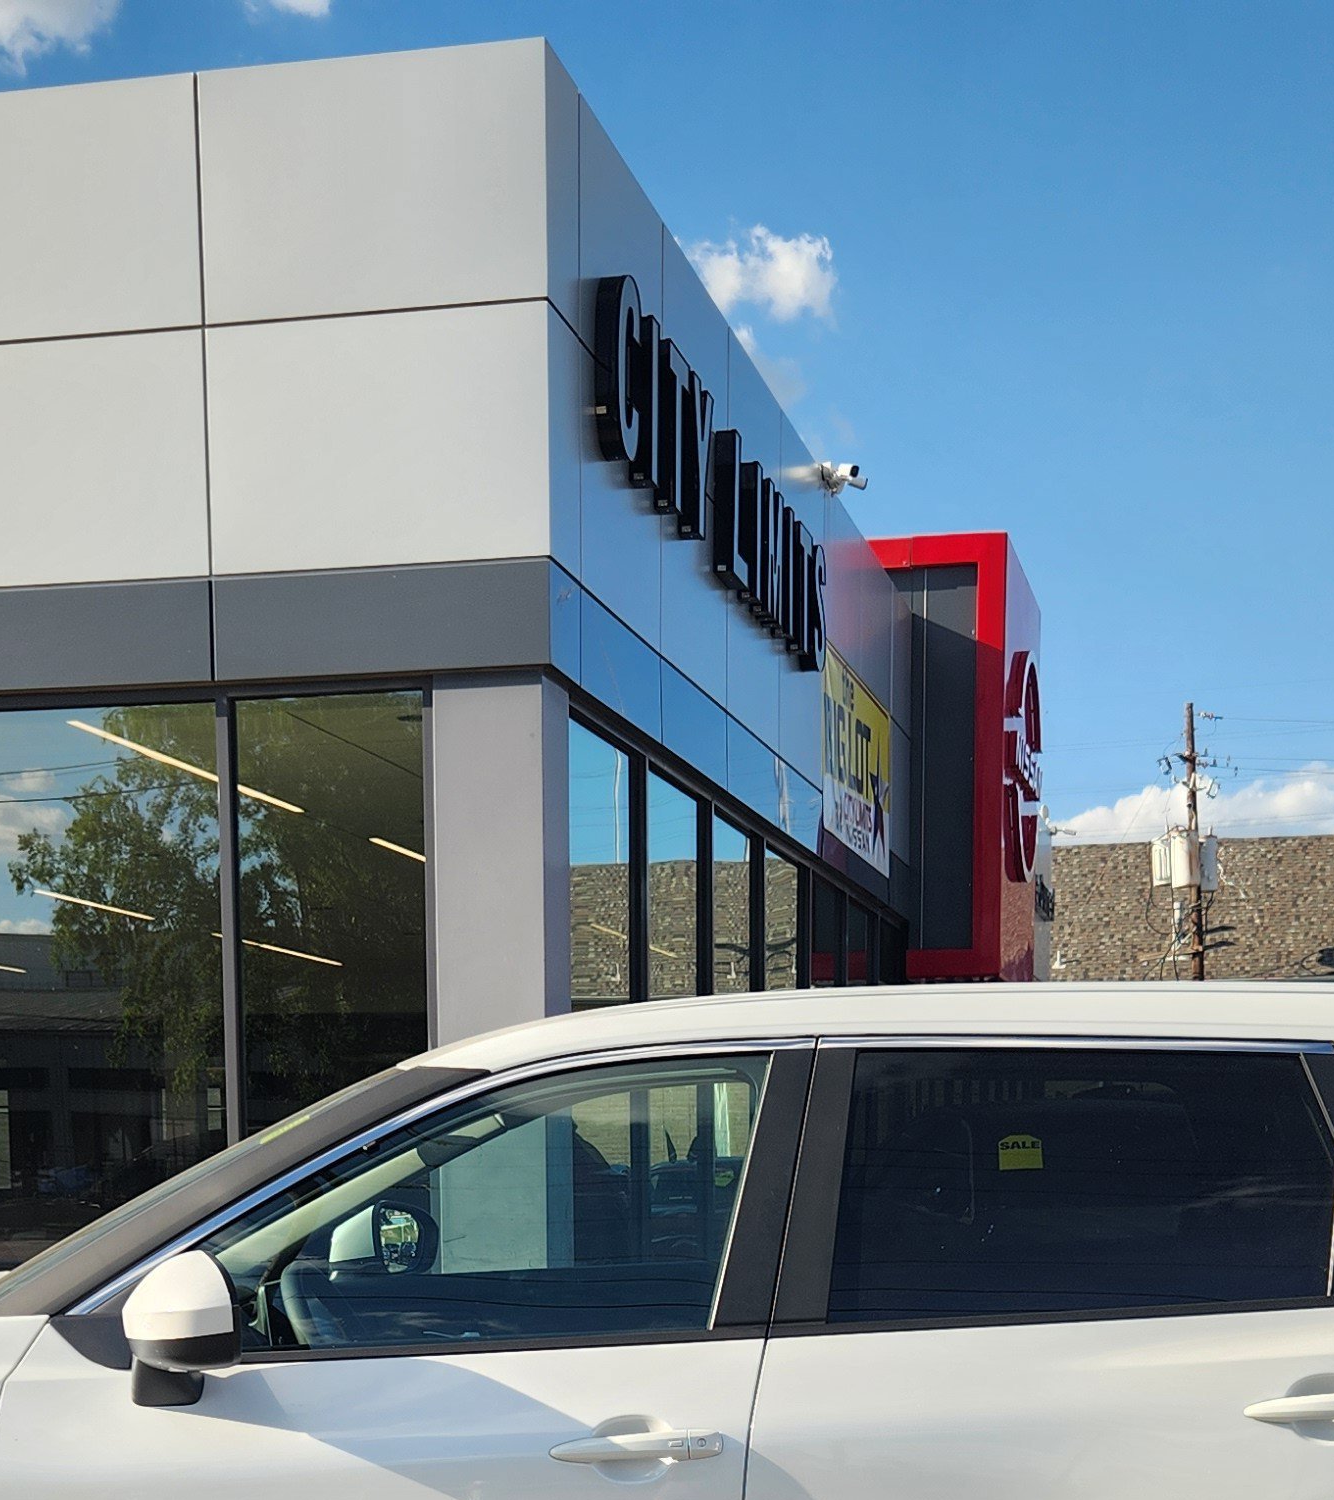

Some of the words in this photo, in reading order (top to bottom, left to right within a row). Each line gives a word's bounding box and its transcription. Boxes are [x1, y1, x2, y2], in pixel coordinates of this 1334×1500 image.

[595, 275, 714, 540] CITY
[713, 429, 826, 672] LIMITS
[999, 1140, 1041, 1151] SALE
